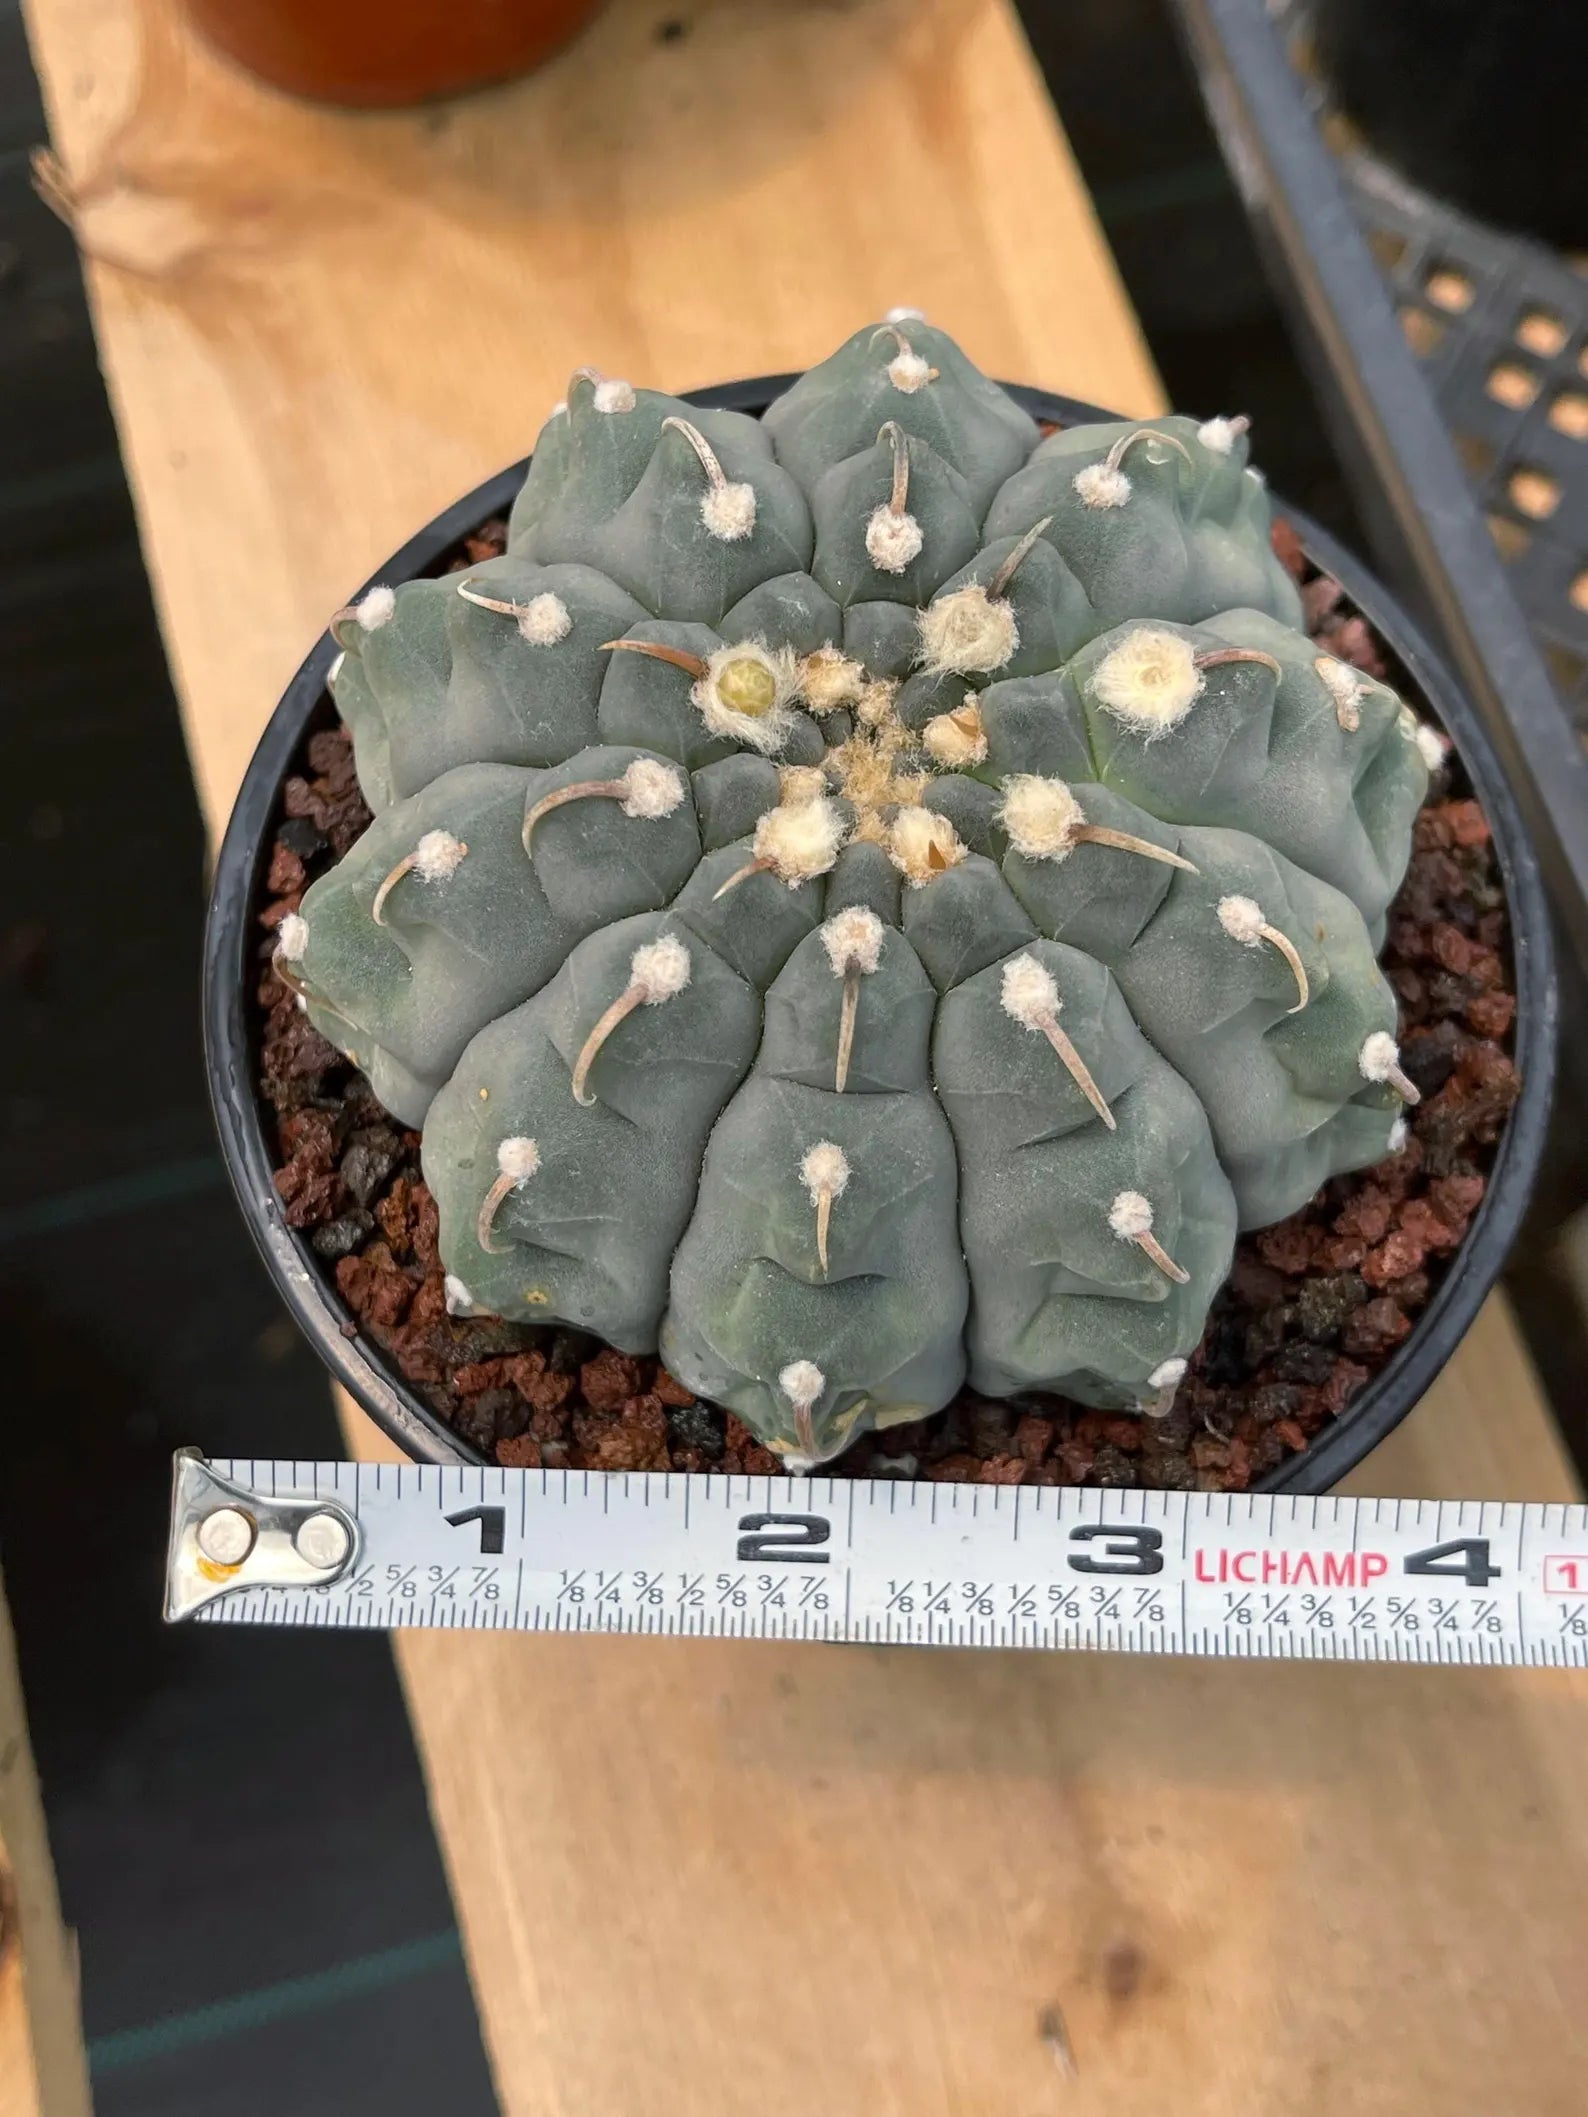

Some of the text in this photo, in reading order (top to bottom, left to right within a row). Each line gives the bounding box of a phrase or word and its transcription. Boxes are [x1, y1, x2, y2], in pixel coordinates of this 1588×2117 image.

[443, 1505, 506, 1554] 1
[737, 1513, 831, 1563] 2
[1067, 1524, 1164, 1575] 3
[1194, 1548, 1388, 1588] LICHAMP
[1403, 1538, 1502, 1586] 4
